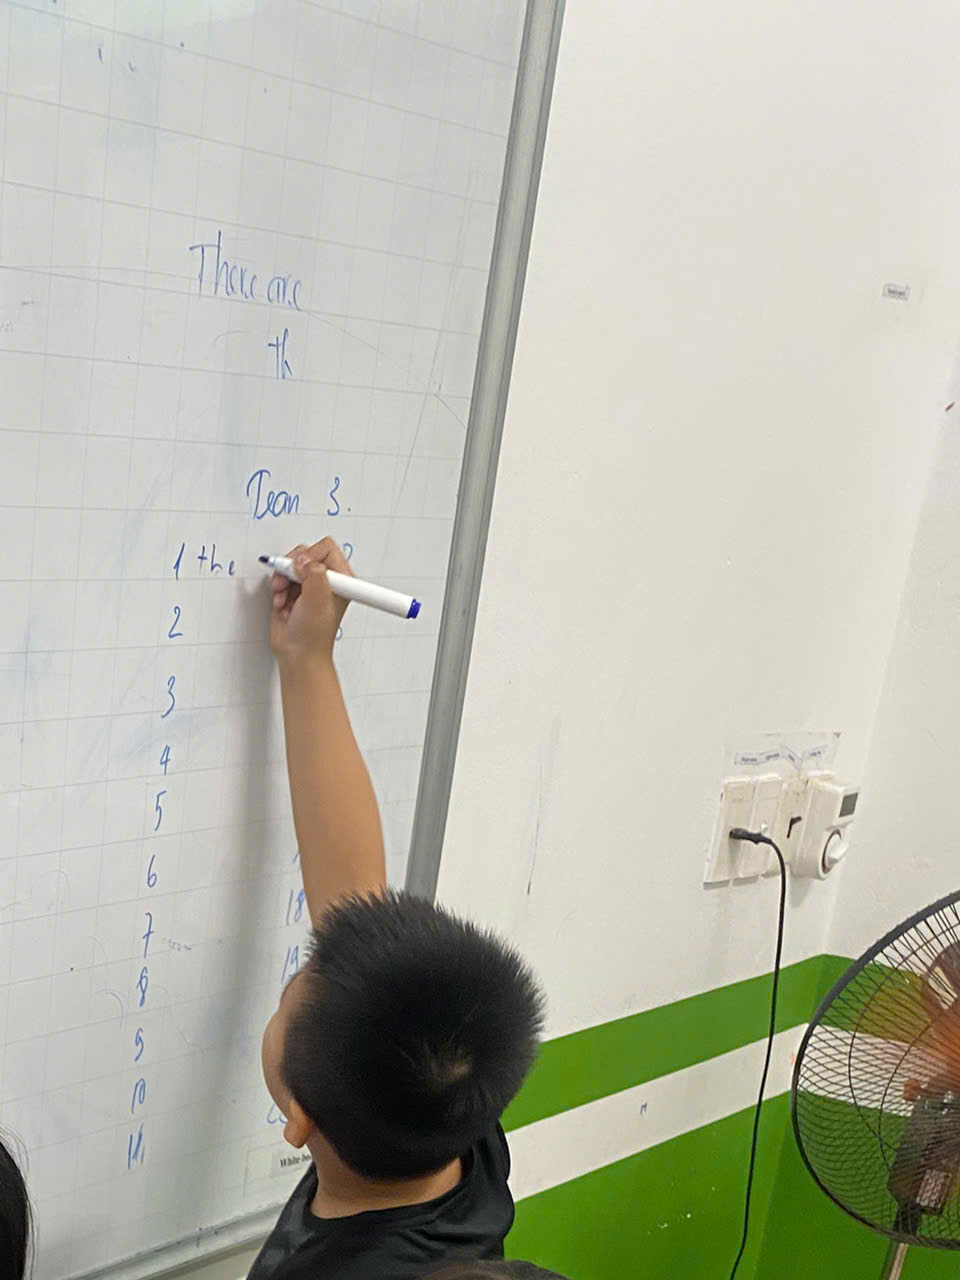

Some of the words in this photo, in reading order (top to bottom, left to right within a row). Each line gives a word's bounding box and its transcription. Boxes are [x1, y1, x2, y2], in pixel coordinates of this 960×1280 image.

[189, 230, 257, 300] There
[167, 605, 184, 639] 2
[160, 674, 176, 719] 3
[159, 744, 172, 777] 4
[154, 789, 168, 832] 5
[146, 853, 158, 889] 6
[142, 911, 156, 960] 7
